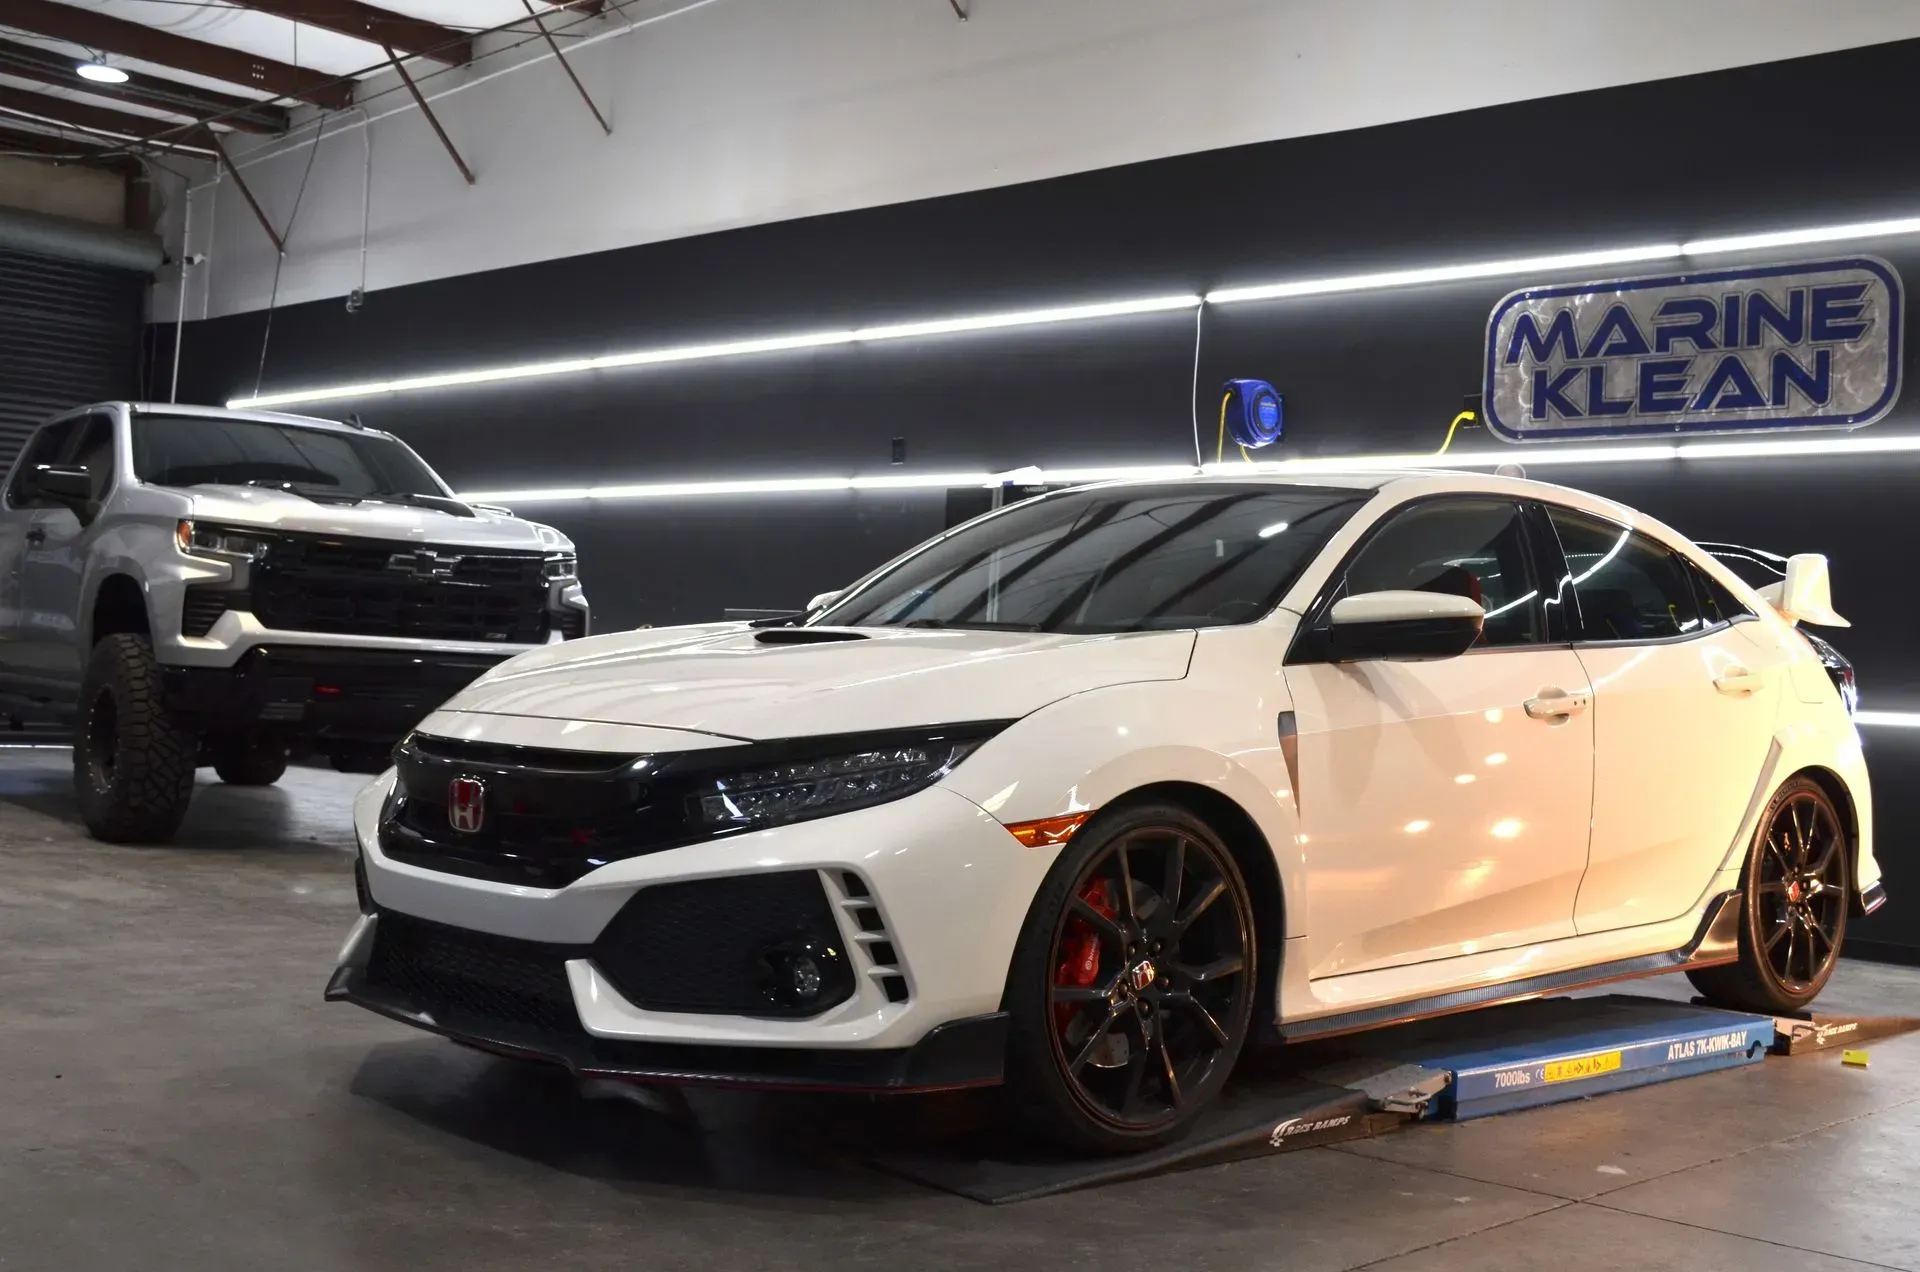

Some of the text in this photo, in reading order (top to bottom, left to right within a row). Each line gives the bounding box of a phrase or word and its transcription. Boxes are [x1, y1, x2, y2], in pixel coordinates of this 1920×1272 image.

[1504, 281, 1876, 365] MARINE
[1530, 348, 1833, 421] KLEAN
[1667, 1030, 1748, 1060] ATLAS 7K-KWIK-BAY
[1494, 1069, 1531, 1088] 7000lbs
[1311, 1115, 1352, 1131] RAMPS
